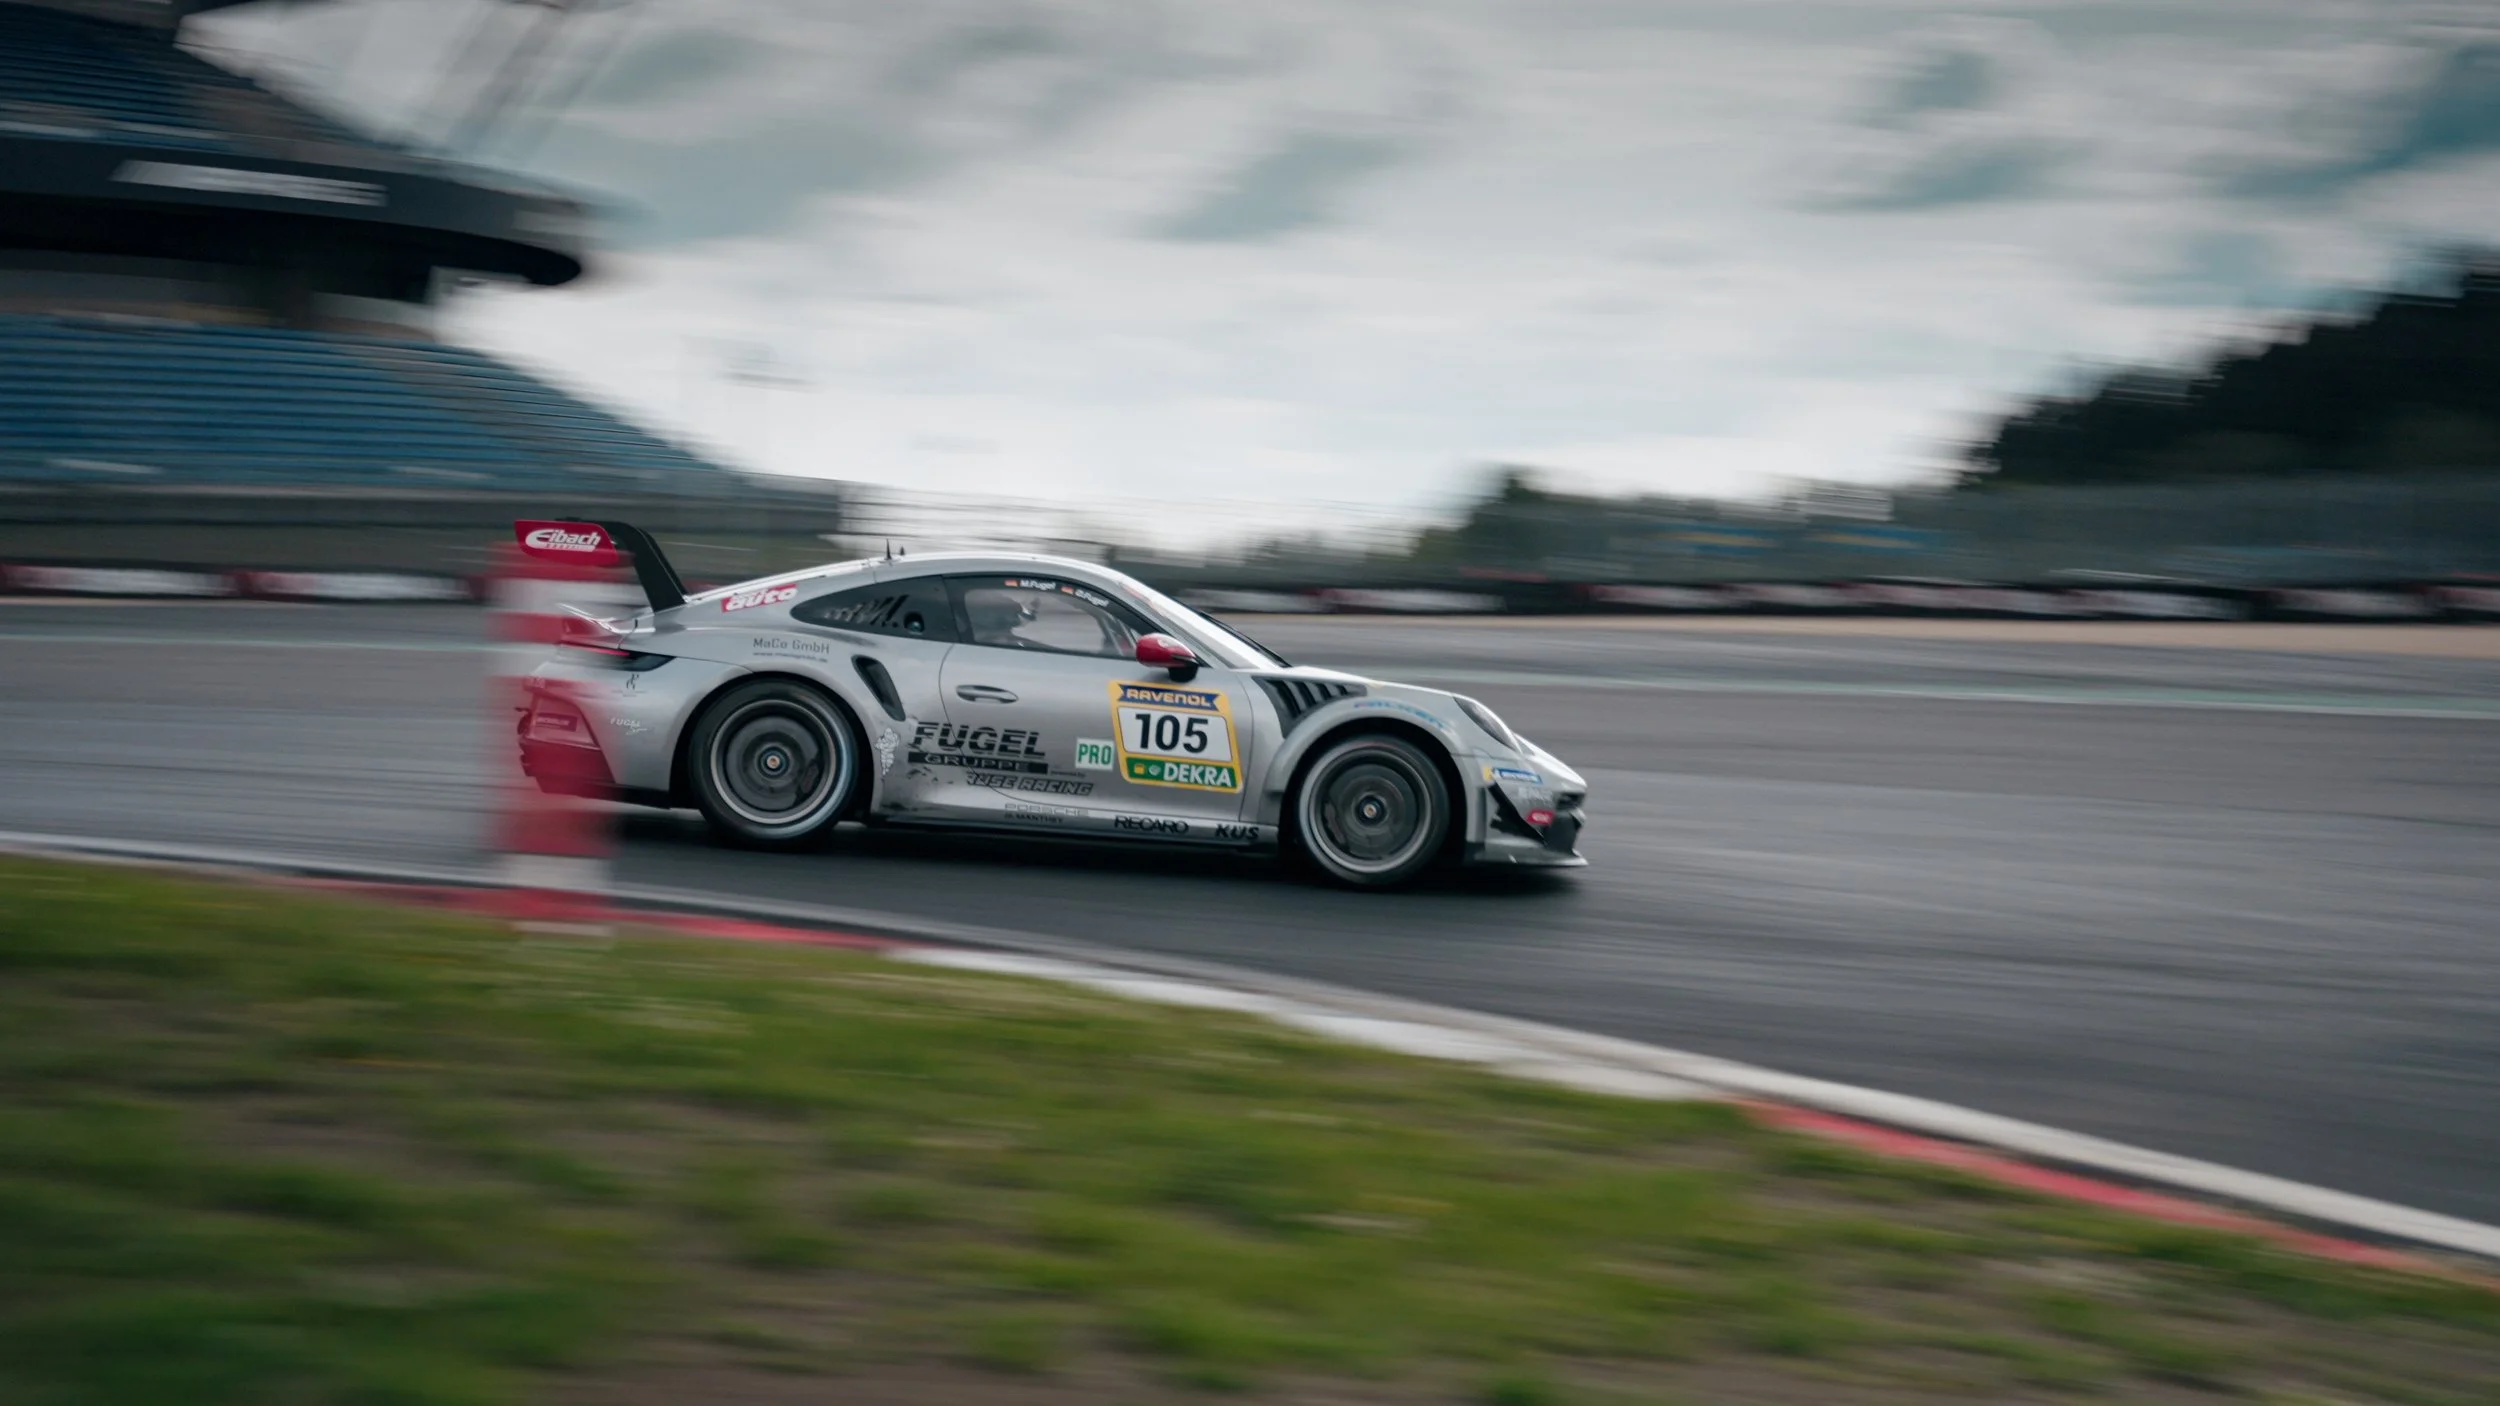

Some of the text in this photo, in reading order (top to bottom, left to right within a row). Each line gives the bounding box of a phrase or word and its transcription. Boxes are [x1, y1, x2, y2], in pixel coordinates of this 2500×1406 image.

[525, 529, 601, 552] Eibach
[725, 588, 798, 611] auto
[753, 637, 830, 655] MaCo GmbH
[1126, 688, 1211, 707] RAVENOL
[911, 721, 1046, 758] FUGEL
[1135, 713, 1209, 753] 105
[924, 753, 1031, 772] GRUPPE
[1077, 743, 1112, 766] PRO
[1017, 776, 1094, 797] RACING
[1163, 762, 1232, 788] DEKRA
[1114, 814, 1189, 835] RECARO
